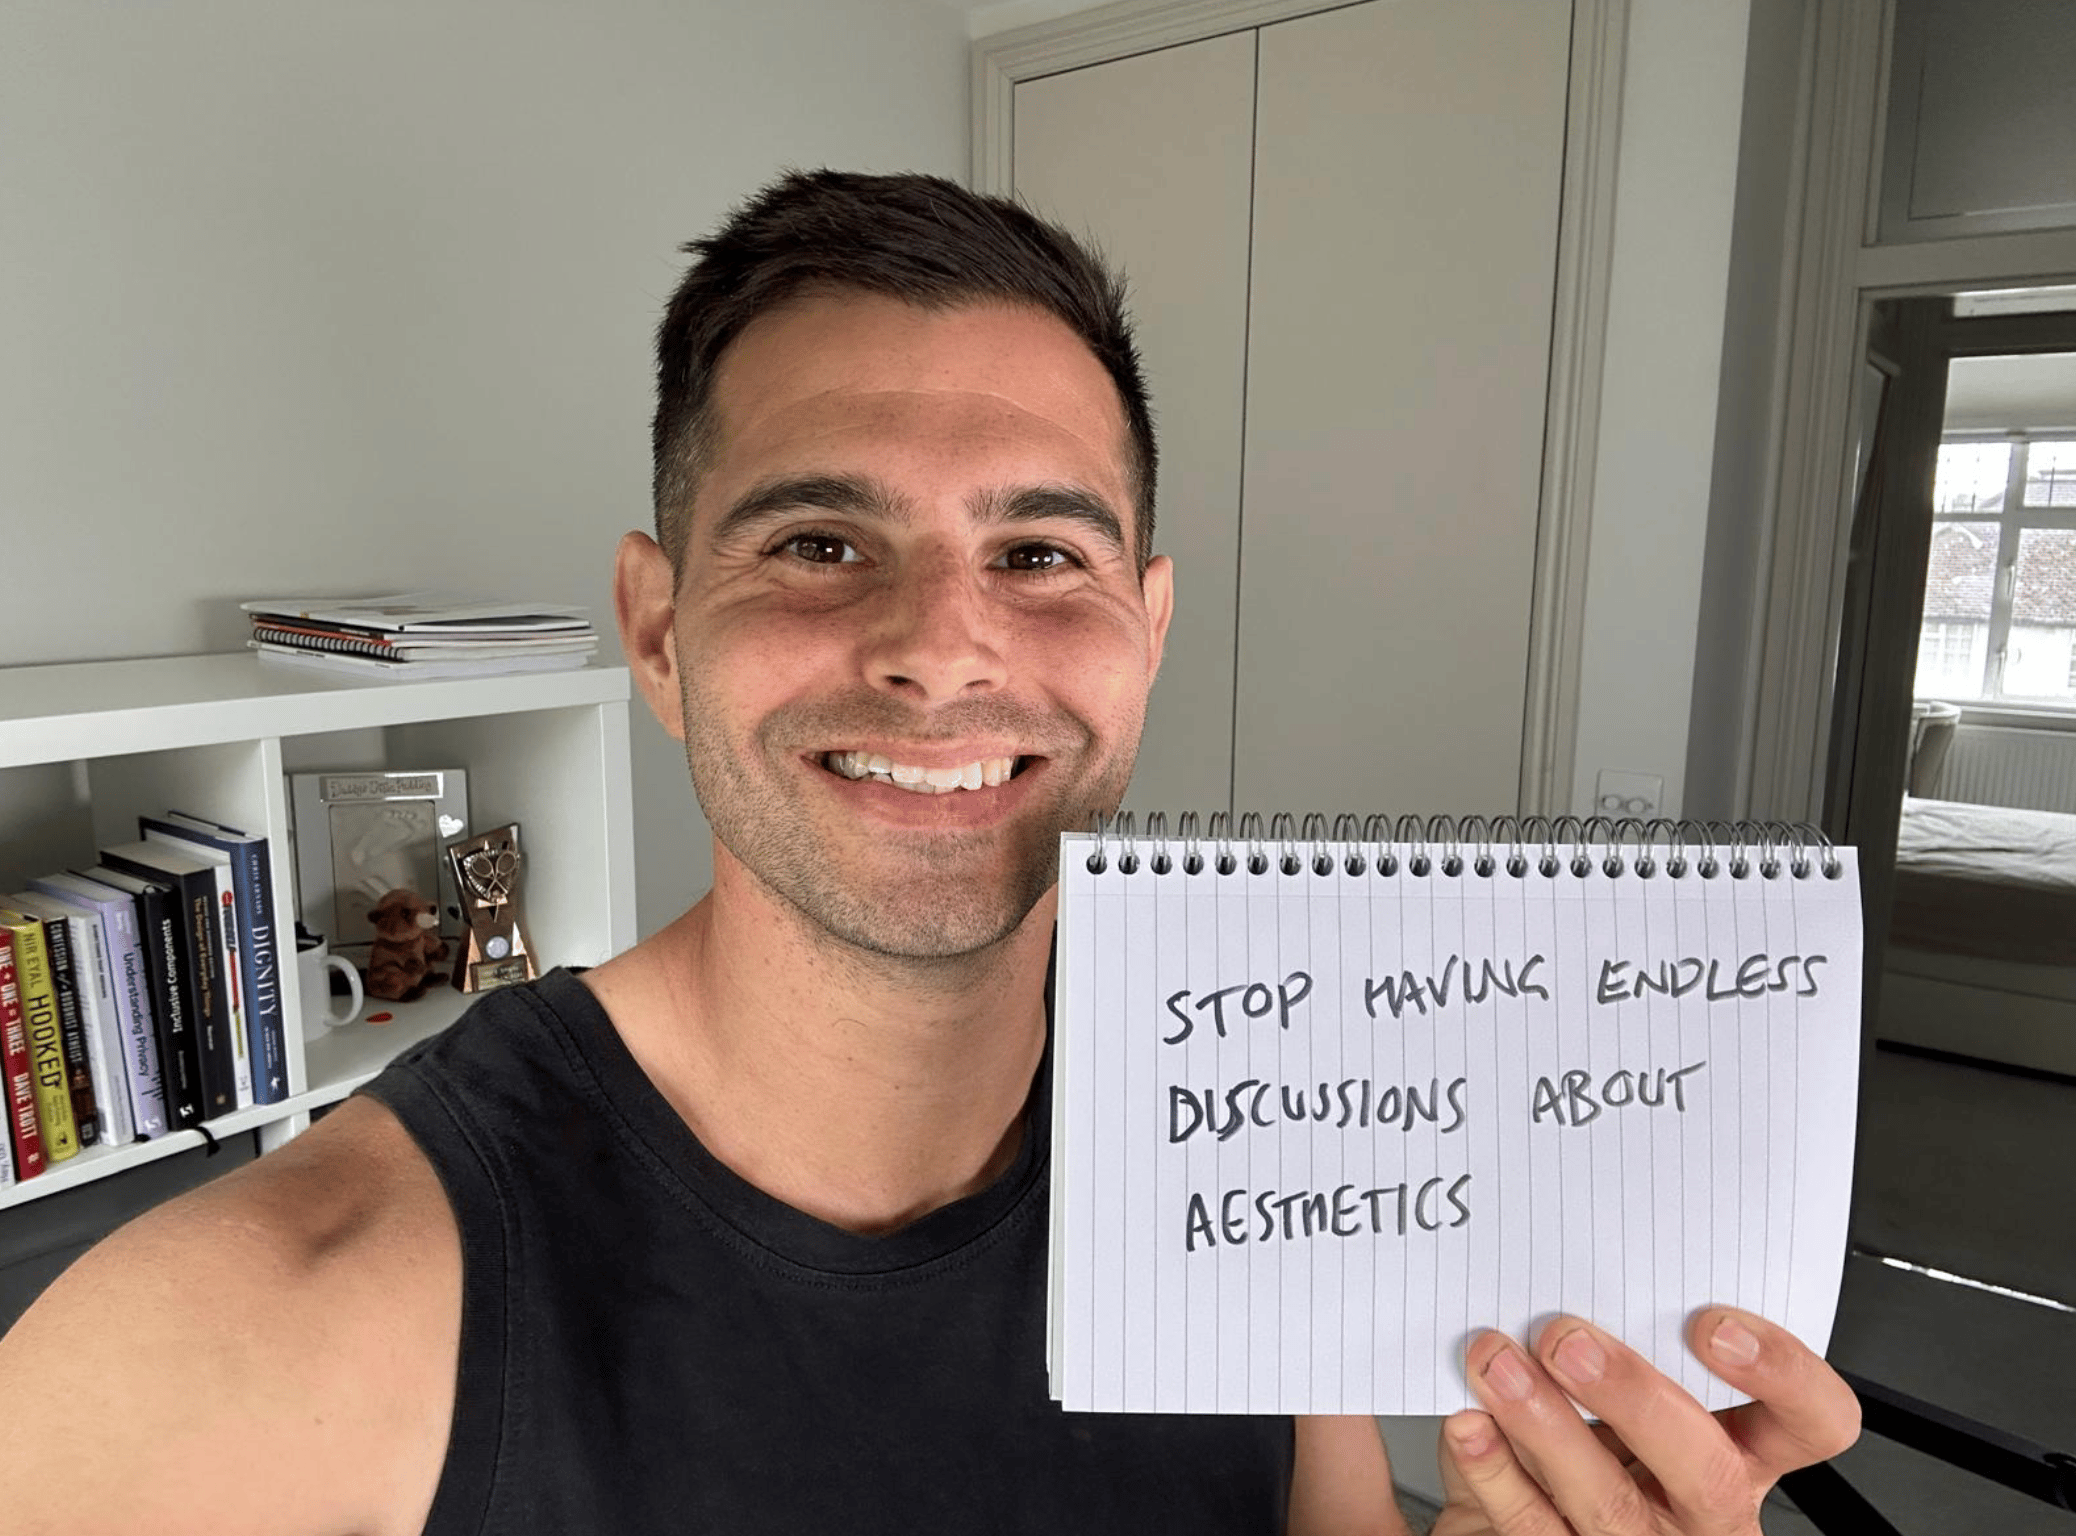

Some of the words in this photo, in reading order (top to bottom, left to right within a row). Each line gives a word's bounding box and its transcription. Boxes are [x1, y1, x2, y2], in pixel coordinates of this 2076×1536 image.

[0, 945, 13, 970] ONE
[23, 931, 39, 954] NIR
[162, 918, 178, 984] Components
[1, 981, 19, 1008] ONE
[27, 956, 43, 988] EYAL
[251, 925, 278, 1016] DIGNITY
[123, 951, 145, 1035] Understanding
[135, 1035, 149, 1077] Privacy
[168, 984, 183, 1034] Inclusive
[1162, 971, 1313, 1046] STOP
[1364, 954, 1549, 1019] HAVING
[1596, 953, 1827, 1005] ENDLESS
[5, 1017, 26, 1056] THREE
[27, 993, 63, 1088] HOOKED
[12, 1071, 33, 1105] DAVE
[1168, 1077, 1467, 1144] DISCUSSIONS
[1532, 1062, 1705, 1127] ABOUT
[18, 1102, 39, 1140] TROTT
[1185, 1173, 1472, 1253] AESTHETICS
